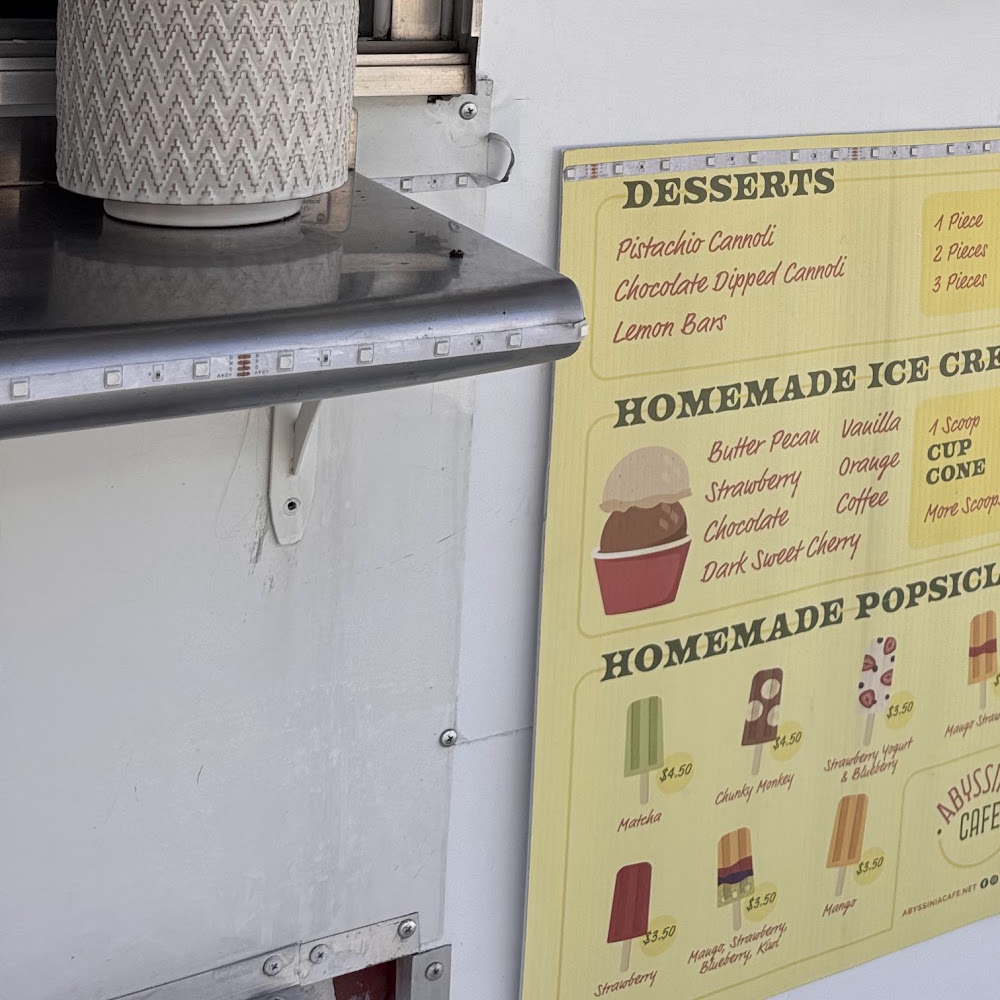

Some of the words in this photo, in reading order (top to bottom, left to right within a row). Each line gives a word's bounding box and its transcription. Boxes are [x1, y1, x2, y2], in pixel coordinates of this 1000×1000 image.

[622, 167, 836, 210] DESSERTS
[934, 214, 943, 231] 1
[948, 211, 984, 231] Piece
[616, 230, 705, 261] Pistachio
[708, 224, 777, 252] Cannoli
[933, 245, 943, 262] 2
[947, 242, 988, 261] Pieces
[614, 274, 708, 302] Chocolate
[712, 260, 782, 297] Dipped
[783, 256, 848, 284] Cannoli
[932, 275, 941, 292] 3
[946, 272, 987, 291] Pieces
[613, 321, 674, 344] Lemon
[681, 313, 728, 335] Bars
[613, 365, 856, 428] HOMEMADE
[867, 355, 930, 389] ICE
[841, 411, 901, 439] Vanilla
[929, 418, 938, 435] 1
[942, 414, 981, 434] Scoop
[707, 437, 766, 463] Butter
[769, 428, 820, 452] Pecan
[927, 438, 972, 461] CUP
[839, 452, 900, 480] Orange
[926, 458, 986, 485] CONE
[705, 468, 802, 503] Strawberry
[836, 487, 889, 514] Coffee
[924, 501, 960, 523] More
[703, 508, 789, 543] Chocolate
[700, 551, 748, 583] Dark
[752, 540, 804, 571] Sweet
[806, 530, 861, 560] Cherry
[601, 597, 844, 682] HOMEMADE
[886, 700, 914, 720] $3.50
[772, 730, 802, 751] $4.50
[944, 719, 974, 738] Mango
[824, 748, 879, 773] Strawberry
[881, 737, 914, 760] Yogurt
[659, 763, 693, 783] $4.50
[840, 771, 848, 783] &
[851, 757, 899, 781] Blueberry
[714, 782, 754, 805] Chunky
[756, 773, 795, 795] Monkey
[617, 808, 662, 832] Matcha
[855, 856, 884, 876] $3.50
[746, 891, 777, 911] $3.50
[822, 898, 857, 917] Mango
[901, 883, 977, 917] ABYSSINIACAFE.NET
[642, 925, 676, 945] $3.50
[699, 950, 752, 974] Blueberry,
[756, 937, 780, 955] Kiwi
[594, 968, 657, 997] Strawberry
